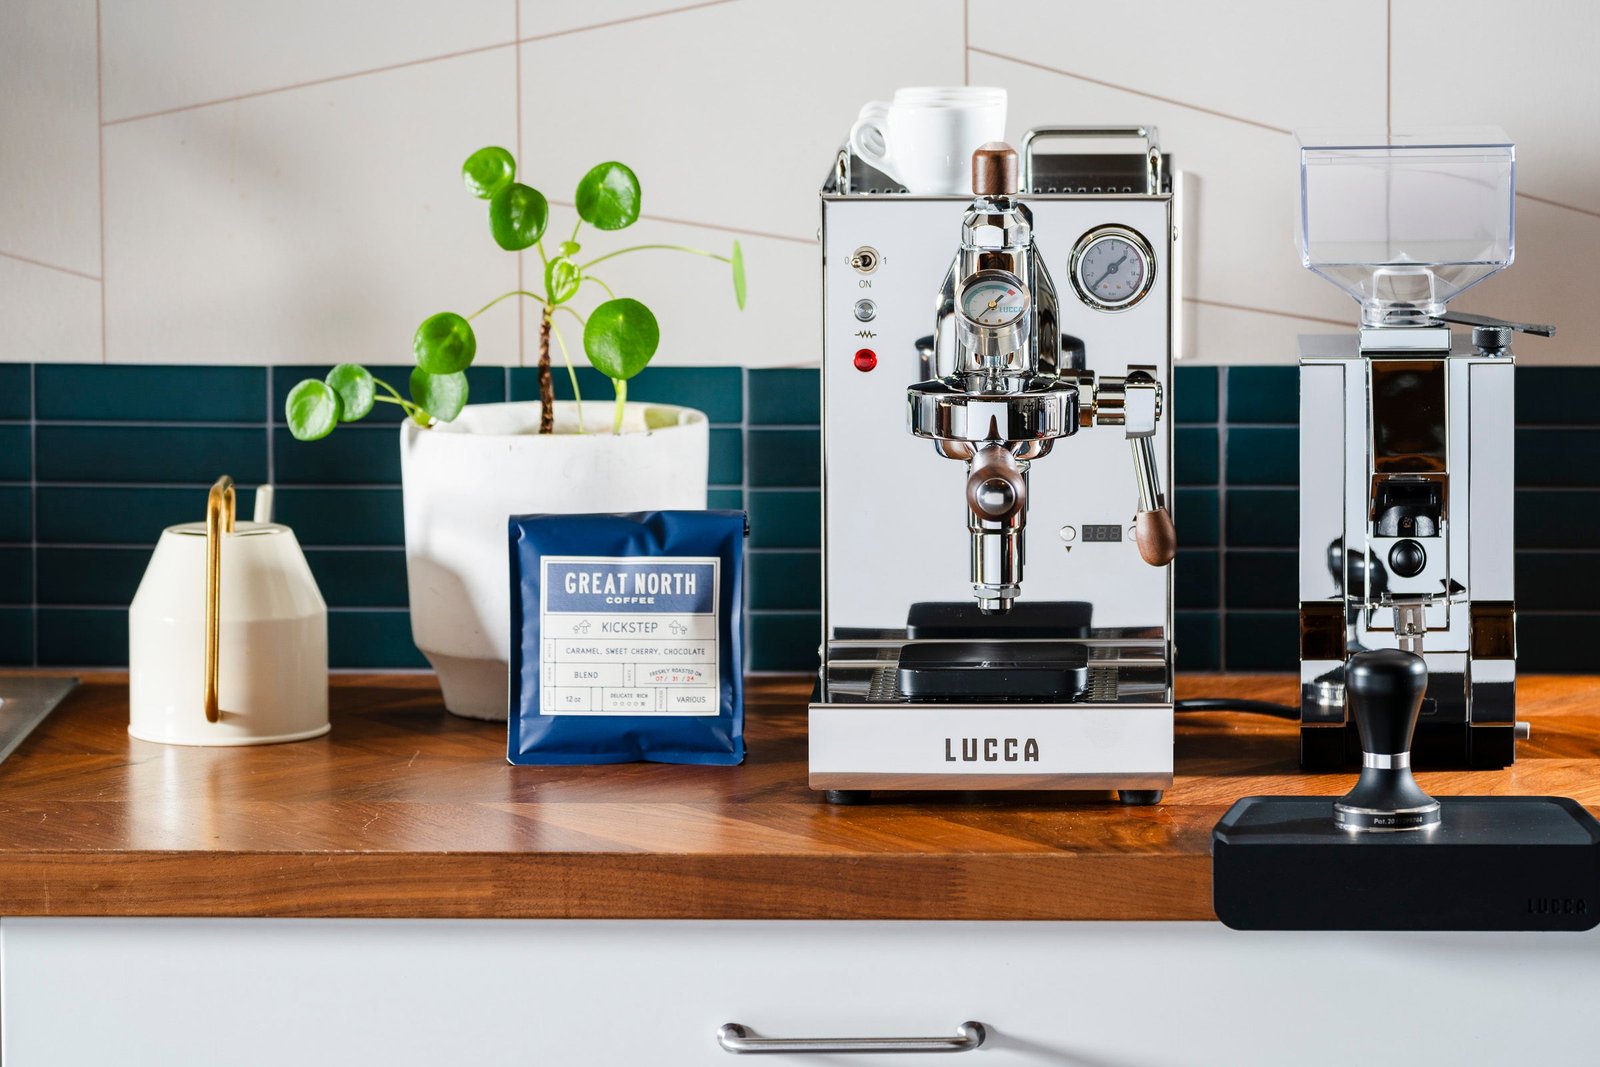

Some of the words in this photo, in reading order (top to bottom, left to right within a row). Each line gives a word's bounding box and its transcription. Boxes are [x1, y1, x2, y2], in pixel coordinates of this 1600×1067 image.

[858, 279, 872, 289] ON
[564, 572, 628, 595] GREAT
[634, 572, 697, 595] NORTH
[605, 596, 656, 605] COFFEE
[601, 621, 659, 634] KICKSTEP
[565, 647, 603, 656] CARAMEL,
[605, 647, 628, 655] SWEET
[630, 647, 662, 656] CHERRY,
[663, 647, 706, 656] CHOCOLATE
[574, 671, 599, 679] BLEND
[676, 696, 706, 704] VARIOUS
[945, 738, 1039, 762] LUCCA
[1527, 897, 1587, 914] LUCCA
